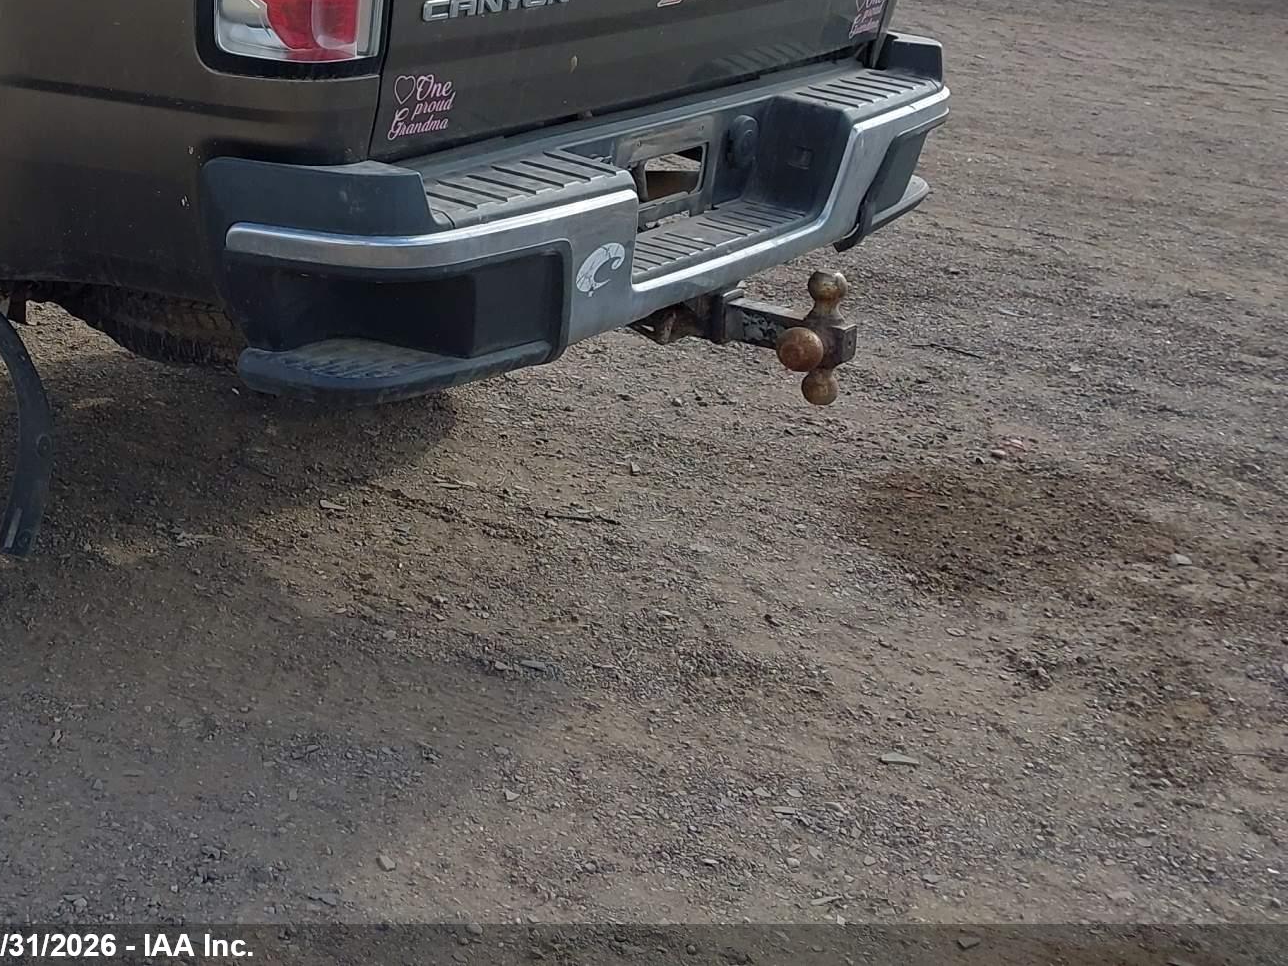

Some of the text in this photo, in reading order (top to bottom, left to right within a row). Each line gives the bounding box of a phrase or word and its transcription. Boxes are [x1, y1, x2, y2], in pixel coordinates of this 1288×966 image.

[416, 74, 453, 101] One
[410, 91, 456, 121] proud
[387, 107, 449, 141] Grandma
